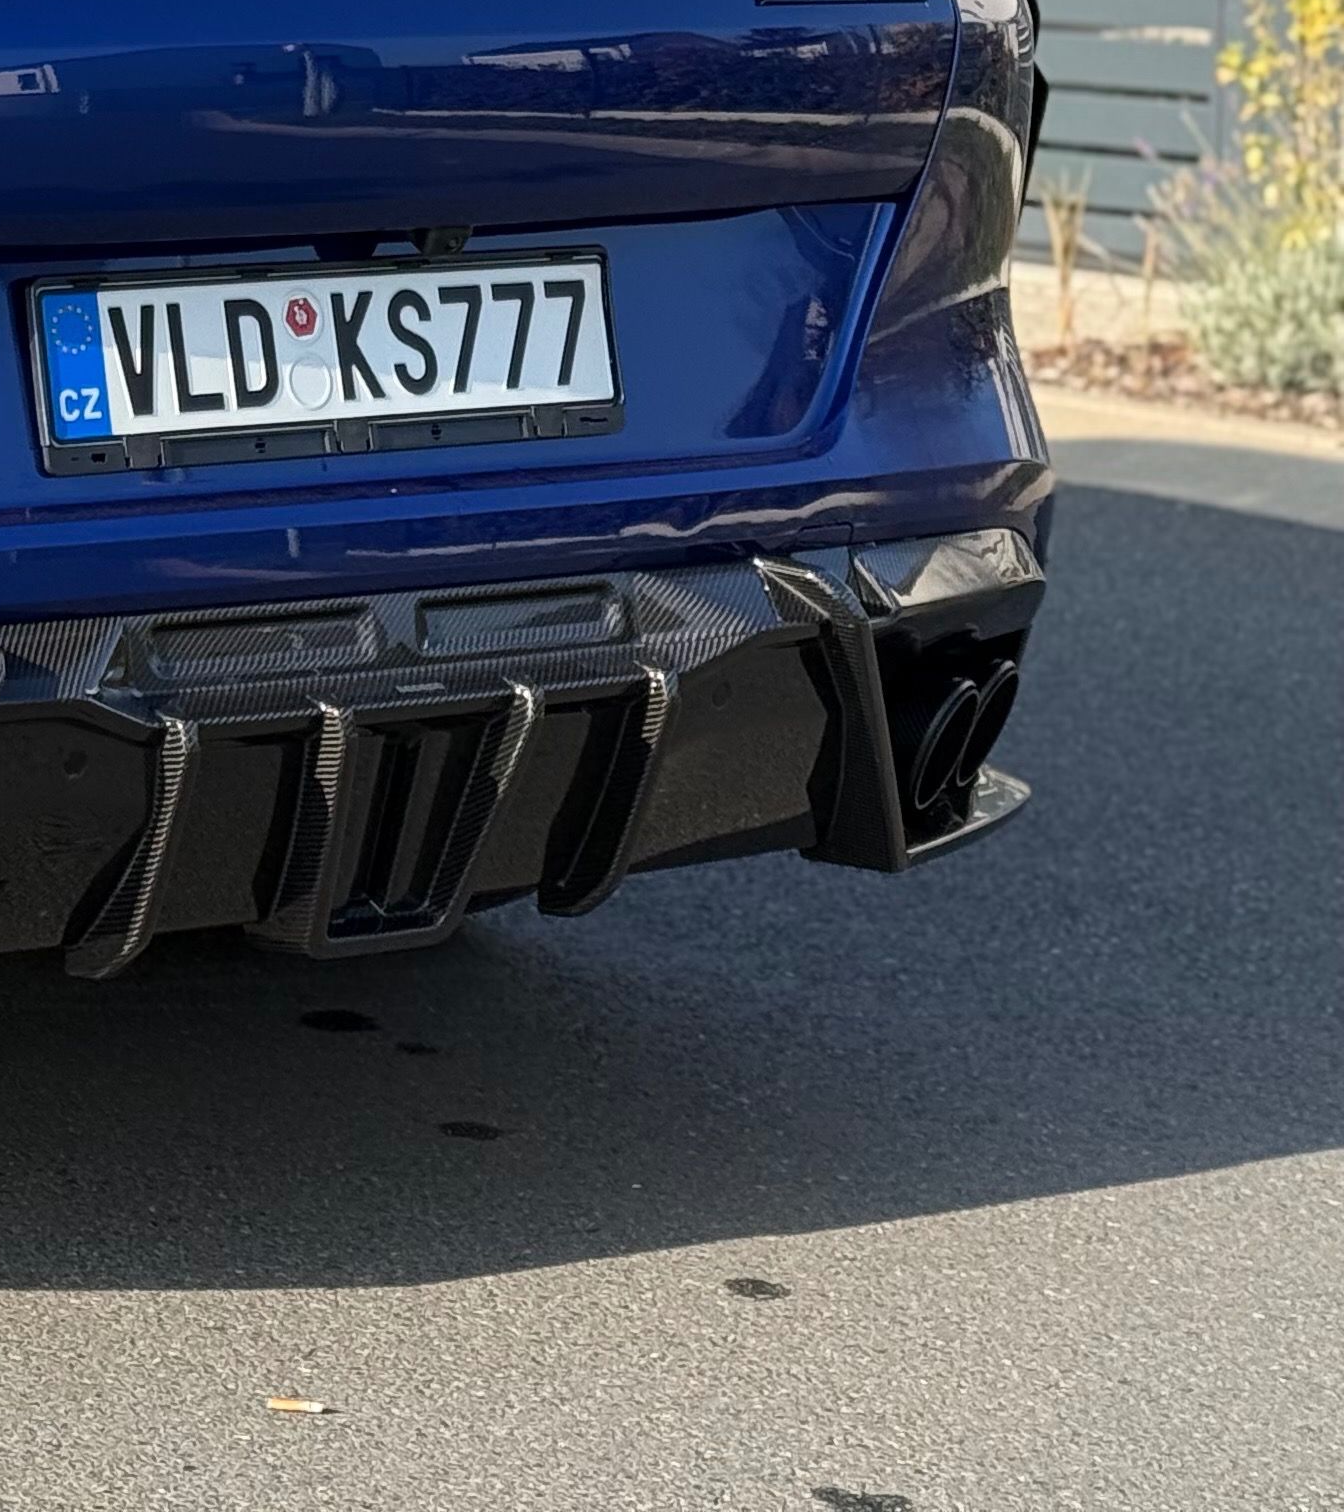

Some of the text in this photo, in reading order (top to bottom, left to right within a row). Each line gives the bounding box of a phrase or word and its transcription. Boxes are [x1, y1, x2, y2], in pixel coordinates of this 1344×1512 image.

[108, 279, 586, 416] VLD KS777
[59, 387, 102, 422] CZ
